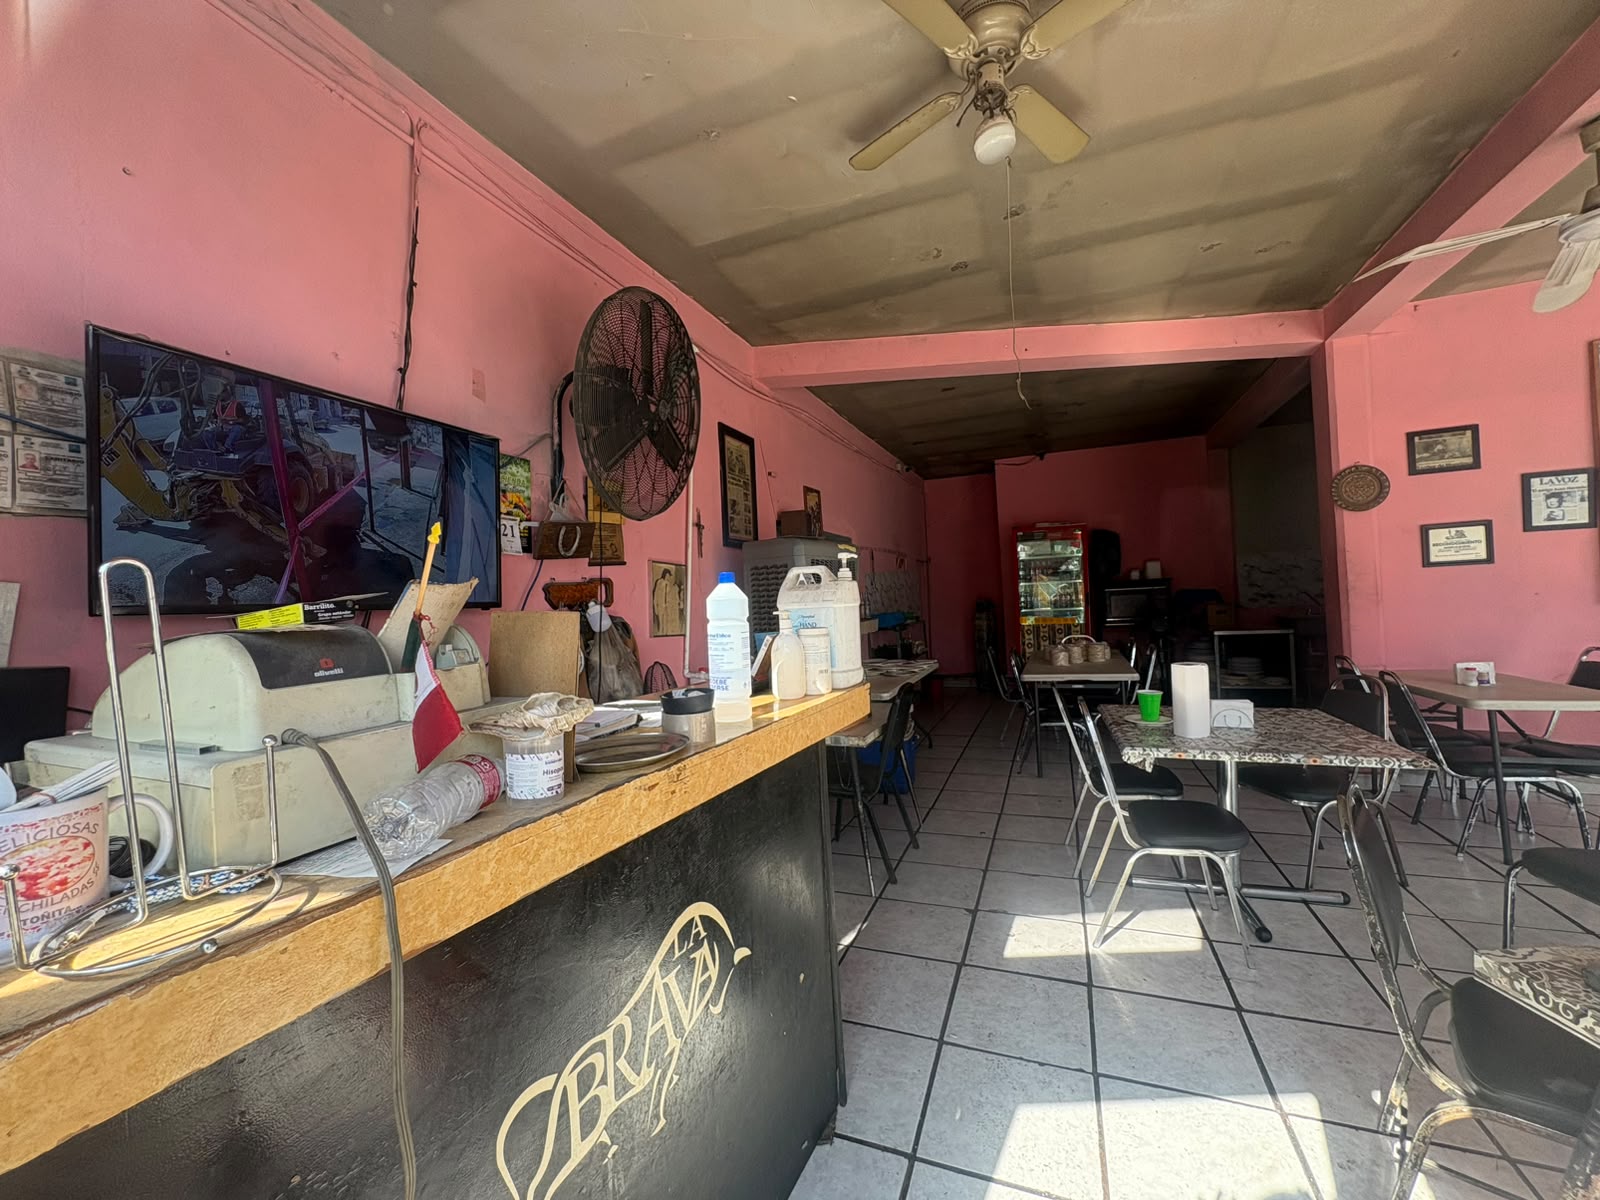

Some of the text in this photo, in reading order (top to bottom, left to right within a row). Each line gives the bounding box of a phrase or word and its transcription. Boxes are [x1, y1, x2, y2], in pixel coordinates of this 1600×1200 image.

[1555, 476, 1579, 484] VOZ
[501, 523, 515, 538] 21
[21, 905, 72, 927] TOÑITA
[672, 915, 707, 961] LA
[564, 939, 720, 1164] BRAVA
